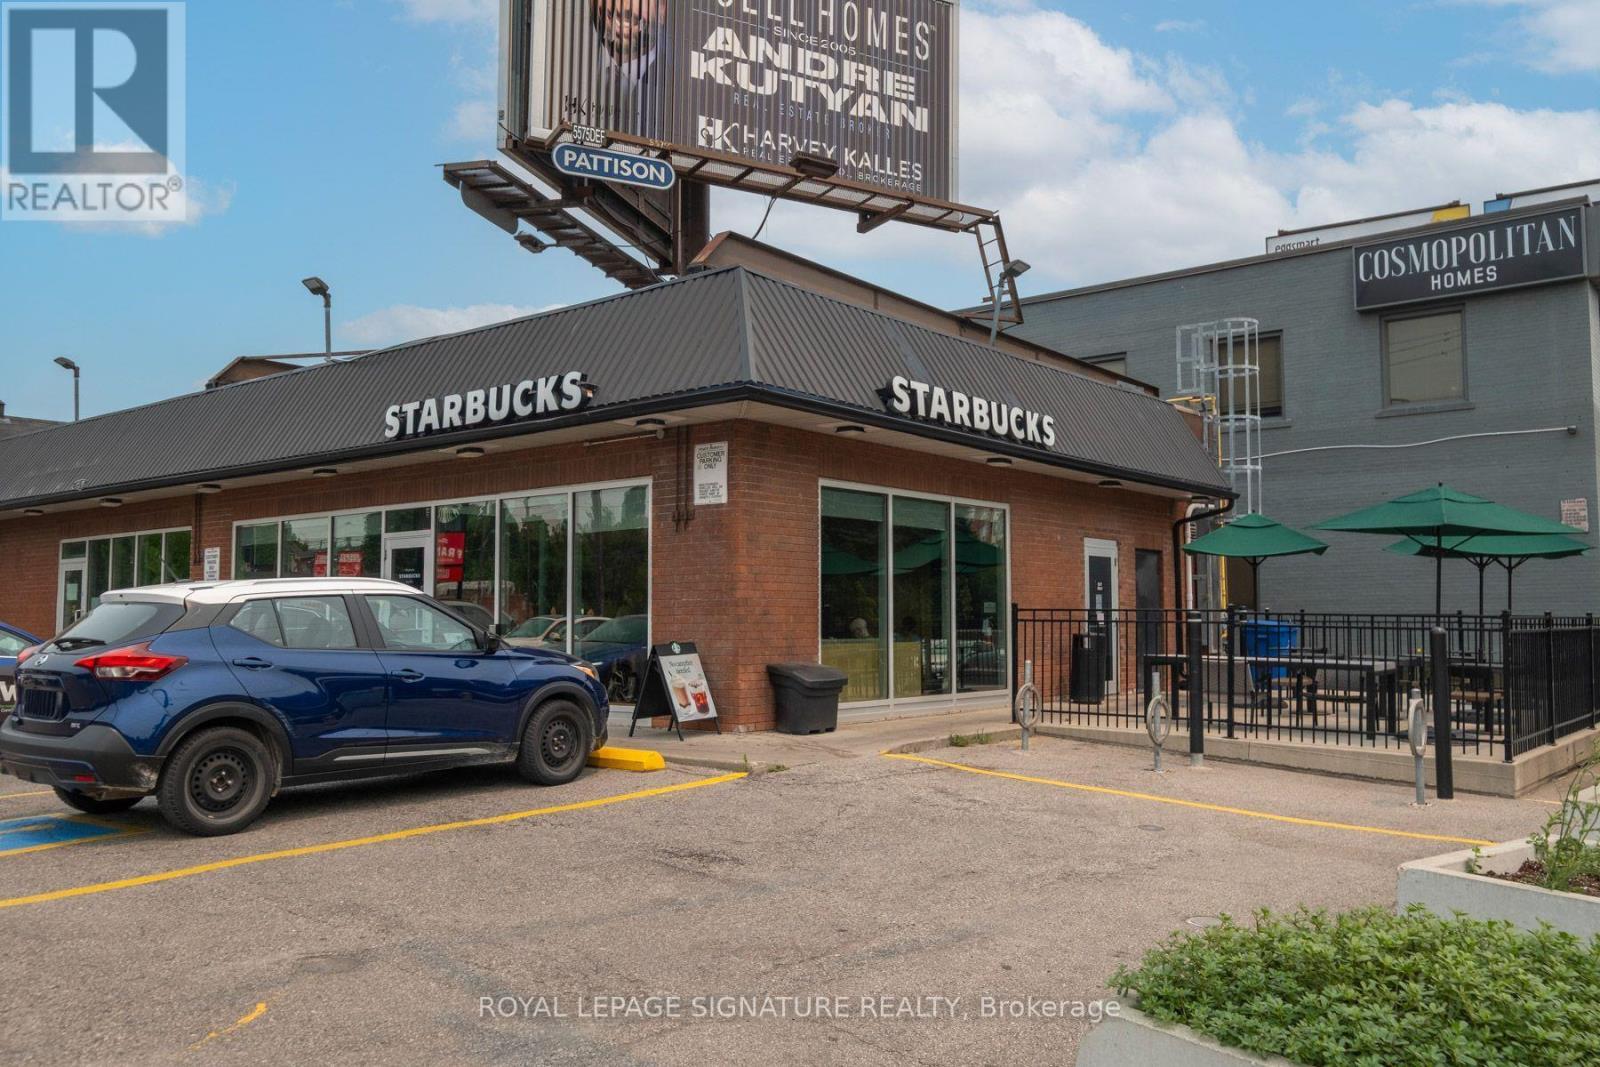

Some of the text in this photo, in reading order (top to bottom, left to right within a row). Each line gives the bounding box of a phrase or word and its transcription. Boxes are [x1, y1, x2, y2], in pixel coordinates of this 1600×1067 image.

[702, 26, 916, 101] ANDRE
[773, 25, 857, 56] SINCE 2005
[690, 51, 929, 132] KUTYAN
[564, 150, 665, 183] PATTISON
[743, 124, 923, 181] HARVEY KALLES
[1359, 215, 1576, 282] COSMOPOLITAN
[1431, 266, 1497, 290] HOMES
[384, 371, 583, 438] STARBUCKS
[892, 375, 1056, 446] STARBUCKS
